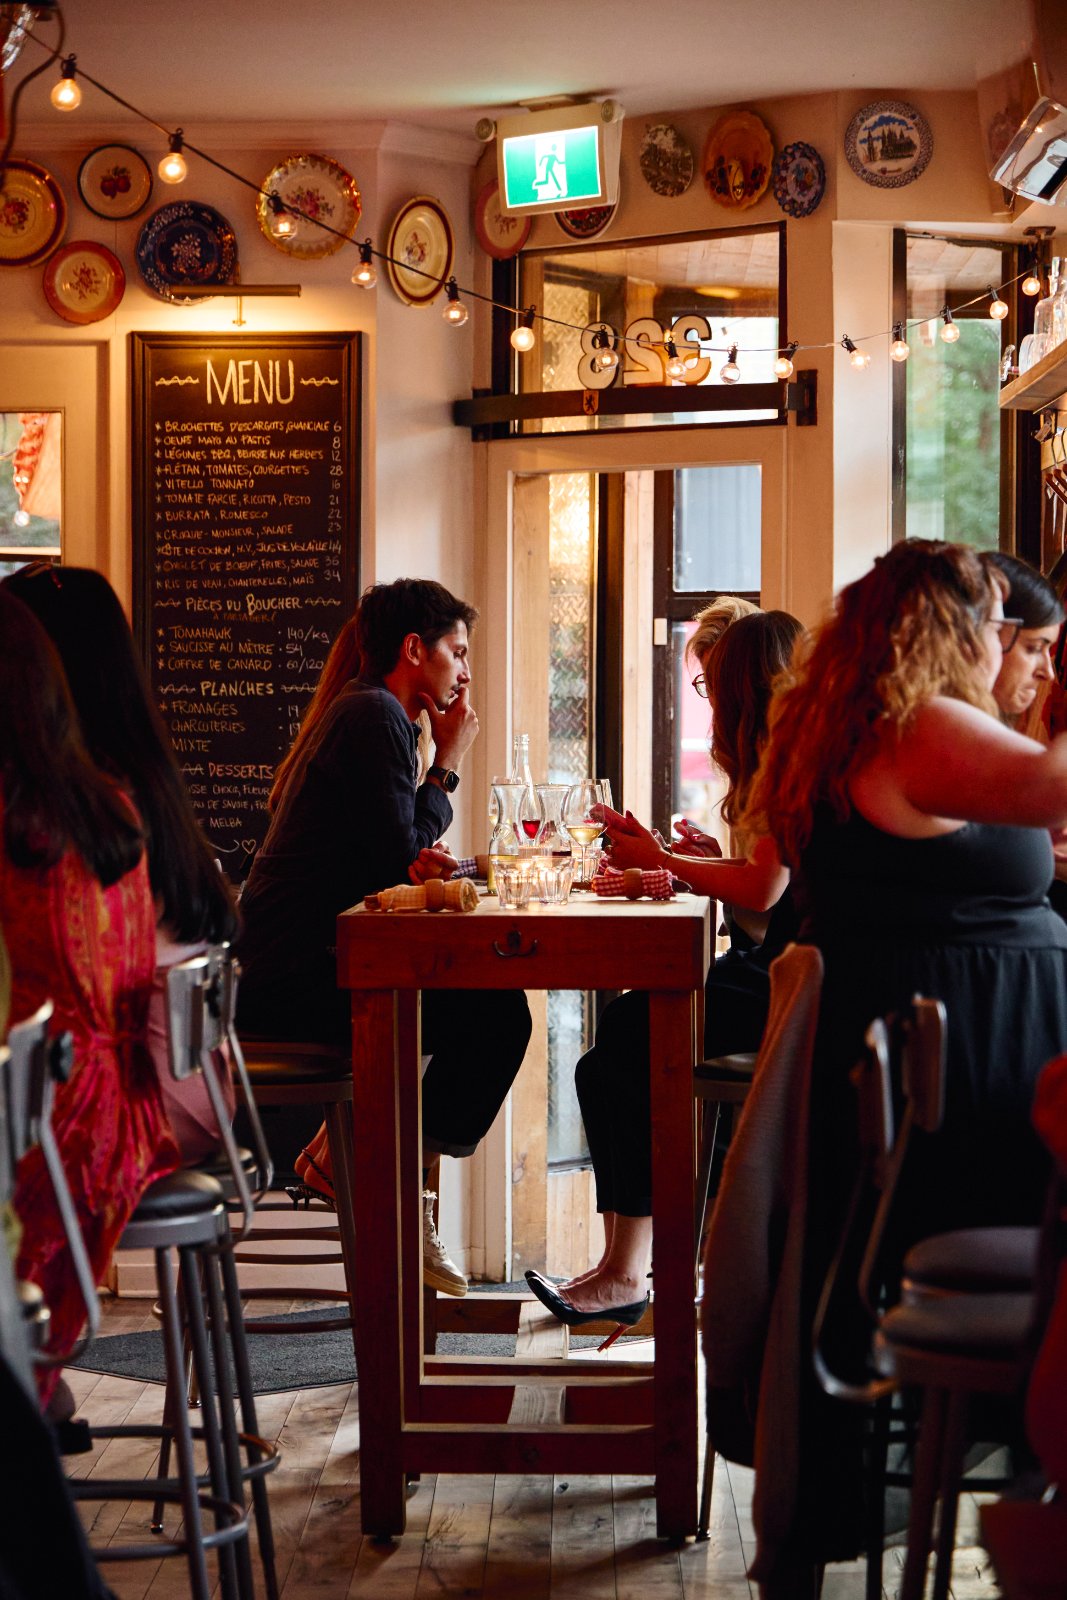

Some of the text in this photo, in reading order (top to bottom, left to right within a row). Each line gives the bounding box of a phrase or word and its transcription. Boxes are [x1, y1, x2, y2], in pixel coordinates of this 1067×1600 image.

[206, 359, 294, 405] MENU
[165, 421, 224, 432] BROCHETTES
[333, 421, 341, 432] 6
[198, 435, 221, 445] MAYO
[226, 435, 237, 445] AU
[333, 436, 341, 449] 8
[332, 450, 341, 461] 12
[253, 464, 310, 476] COURGETTES
[329, 465, 343, 476] 28
[165, 478, 341, 490] VITELLO TONNATO 16
[165, 493, 204, 504] TOMATE
[283, 493, 311, 505] PESTO
[329, 495, 339, 505] 21
[220, 509, 268, 520] ROMESCO
[328, 509, 342, 519] 22
[261, 524, 293, 535] SALADE
[328, 522, 341, 532] 23
[210, 561, 222, 571] DE
[186, 580, 198, 589] DE
[324, 569, 341, 582] 34
[185, 593, 303, 616] PIÈCES DU BOUCHER
[168, 626, 232, 640] TOMAHAWK
[169, 641, 216, 653] SAUCISSE
[220, 641, 234, 653] AU
[285, 643, 303, 657] 54
[167, 657, 205, 672] COFFRE
[209, 659, 222, 671] DE
[227, 659, 272, 671] CANARD
[200, 680, 275, 697] PLANCHES
[172, 700, 239, 716] FROMAGES
[171, 738, 212, 752] MIXTE
[208, 762, 274, 779] DESSERTS
[209, 818, 242, 829] MELBA
